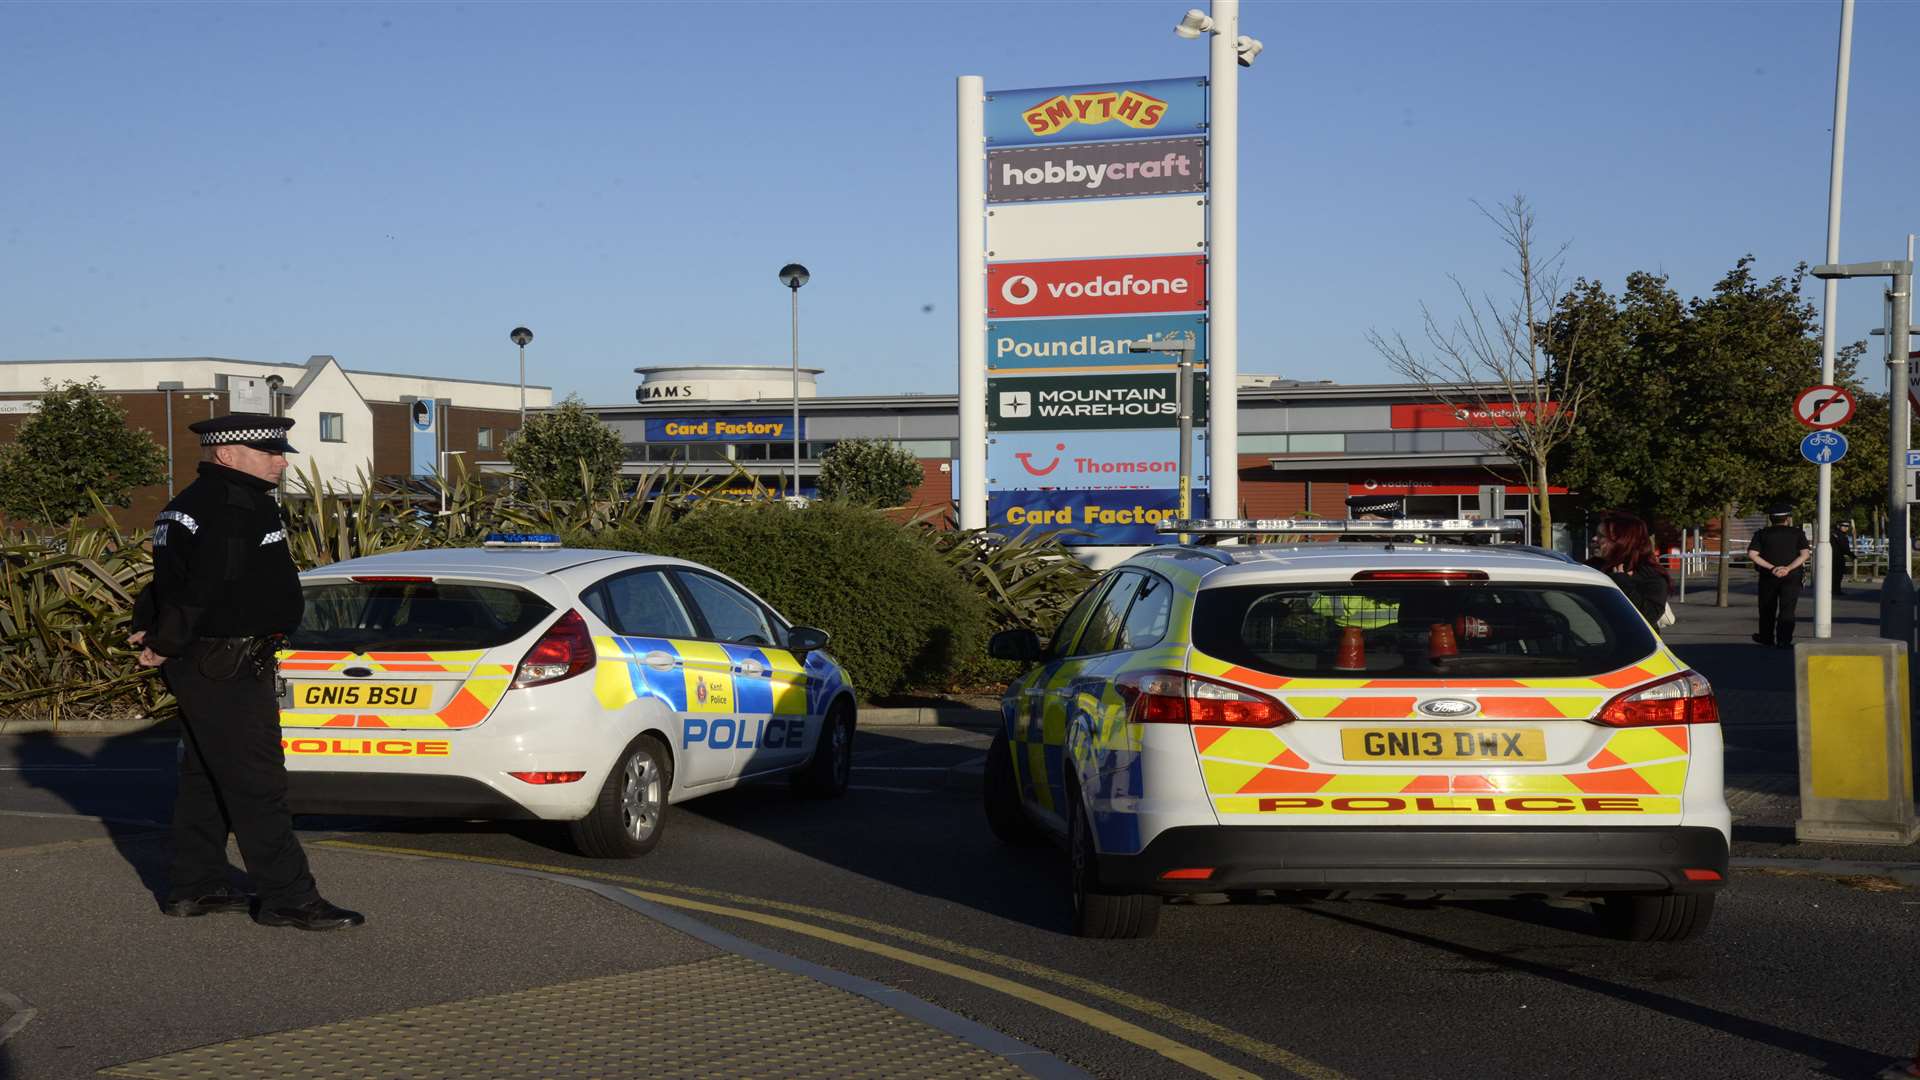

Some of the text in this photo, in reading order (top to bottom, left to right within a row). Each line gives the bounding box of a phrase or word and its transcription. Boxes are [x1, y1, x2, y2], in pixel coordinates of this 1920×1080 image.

[1027, 97, 1164, 133] SMYTHS
[1002, 153, 1191, 188] hobbycraft
[1048, 274, 1189, 298] vodafone
[1039, 388, 1166, 402] MOUNTAIN
[1038, 402, 1181, 417] WAREHOUS
[665, 421, 784, 436] Card Factory
[1074, 458, 1177, 473] Thomson
[1006, 506, 1072, 525] Card
[305, 686, 417, 705] GN15 BSU
[710, 695, 727, 705] Police
[683, 719, 805, 750] POLICE
[1364, 732, 1524, 757] GN13 DWX
[1258, 798, 1644, 812] POLICE
